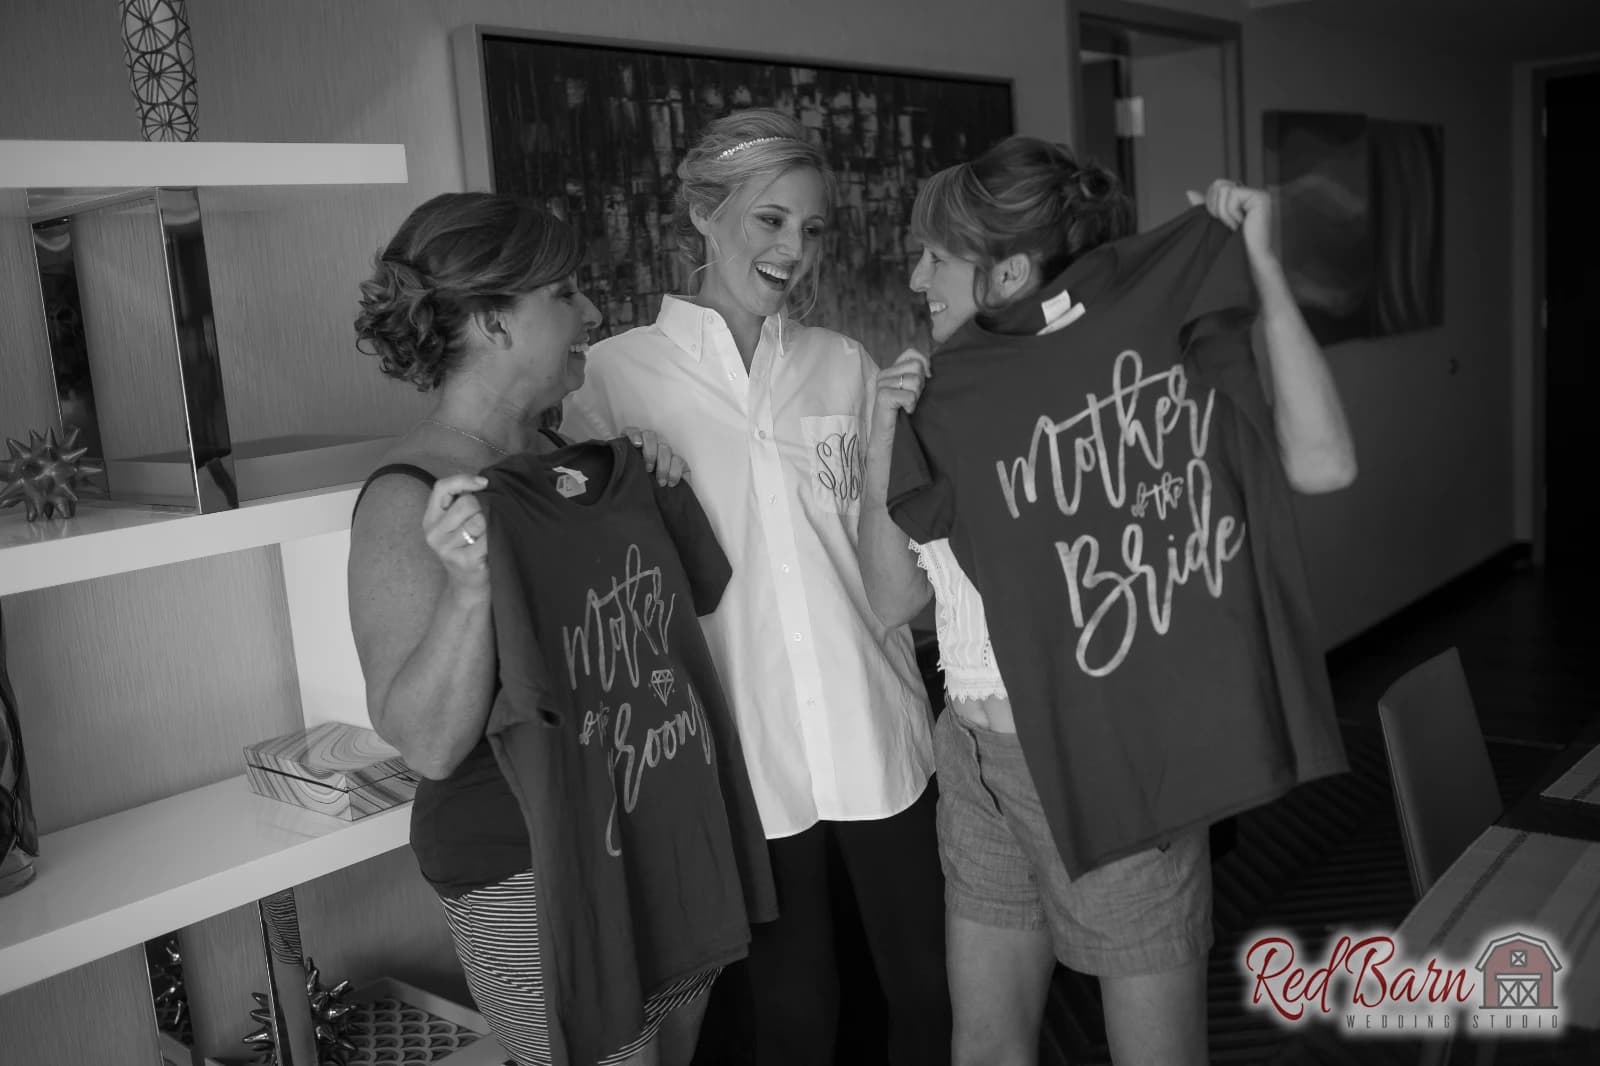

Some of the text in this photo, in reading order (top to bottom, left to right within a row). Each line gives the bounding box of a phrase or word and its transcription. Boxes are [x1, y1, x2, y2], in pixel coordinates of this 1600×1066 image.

[995, 350, 1216, 519] Mother
[1152, 471, 1184, 520] the
[562, 543, 676, 692] Mother
[1055, 458, 1246, 677] Bride
